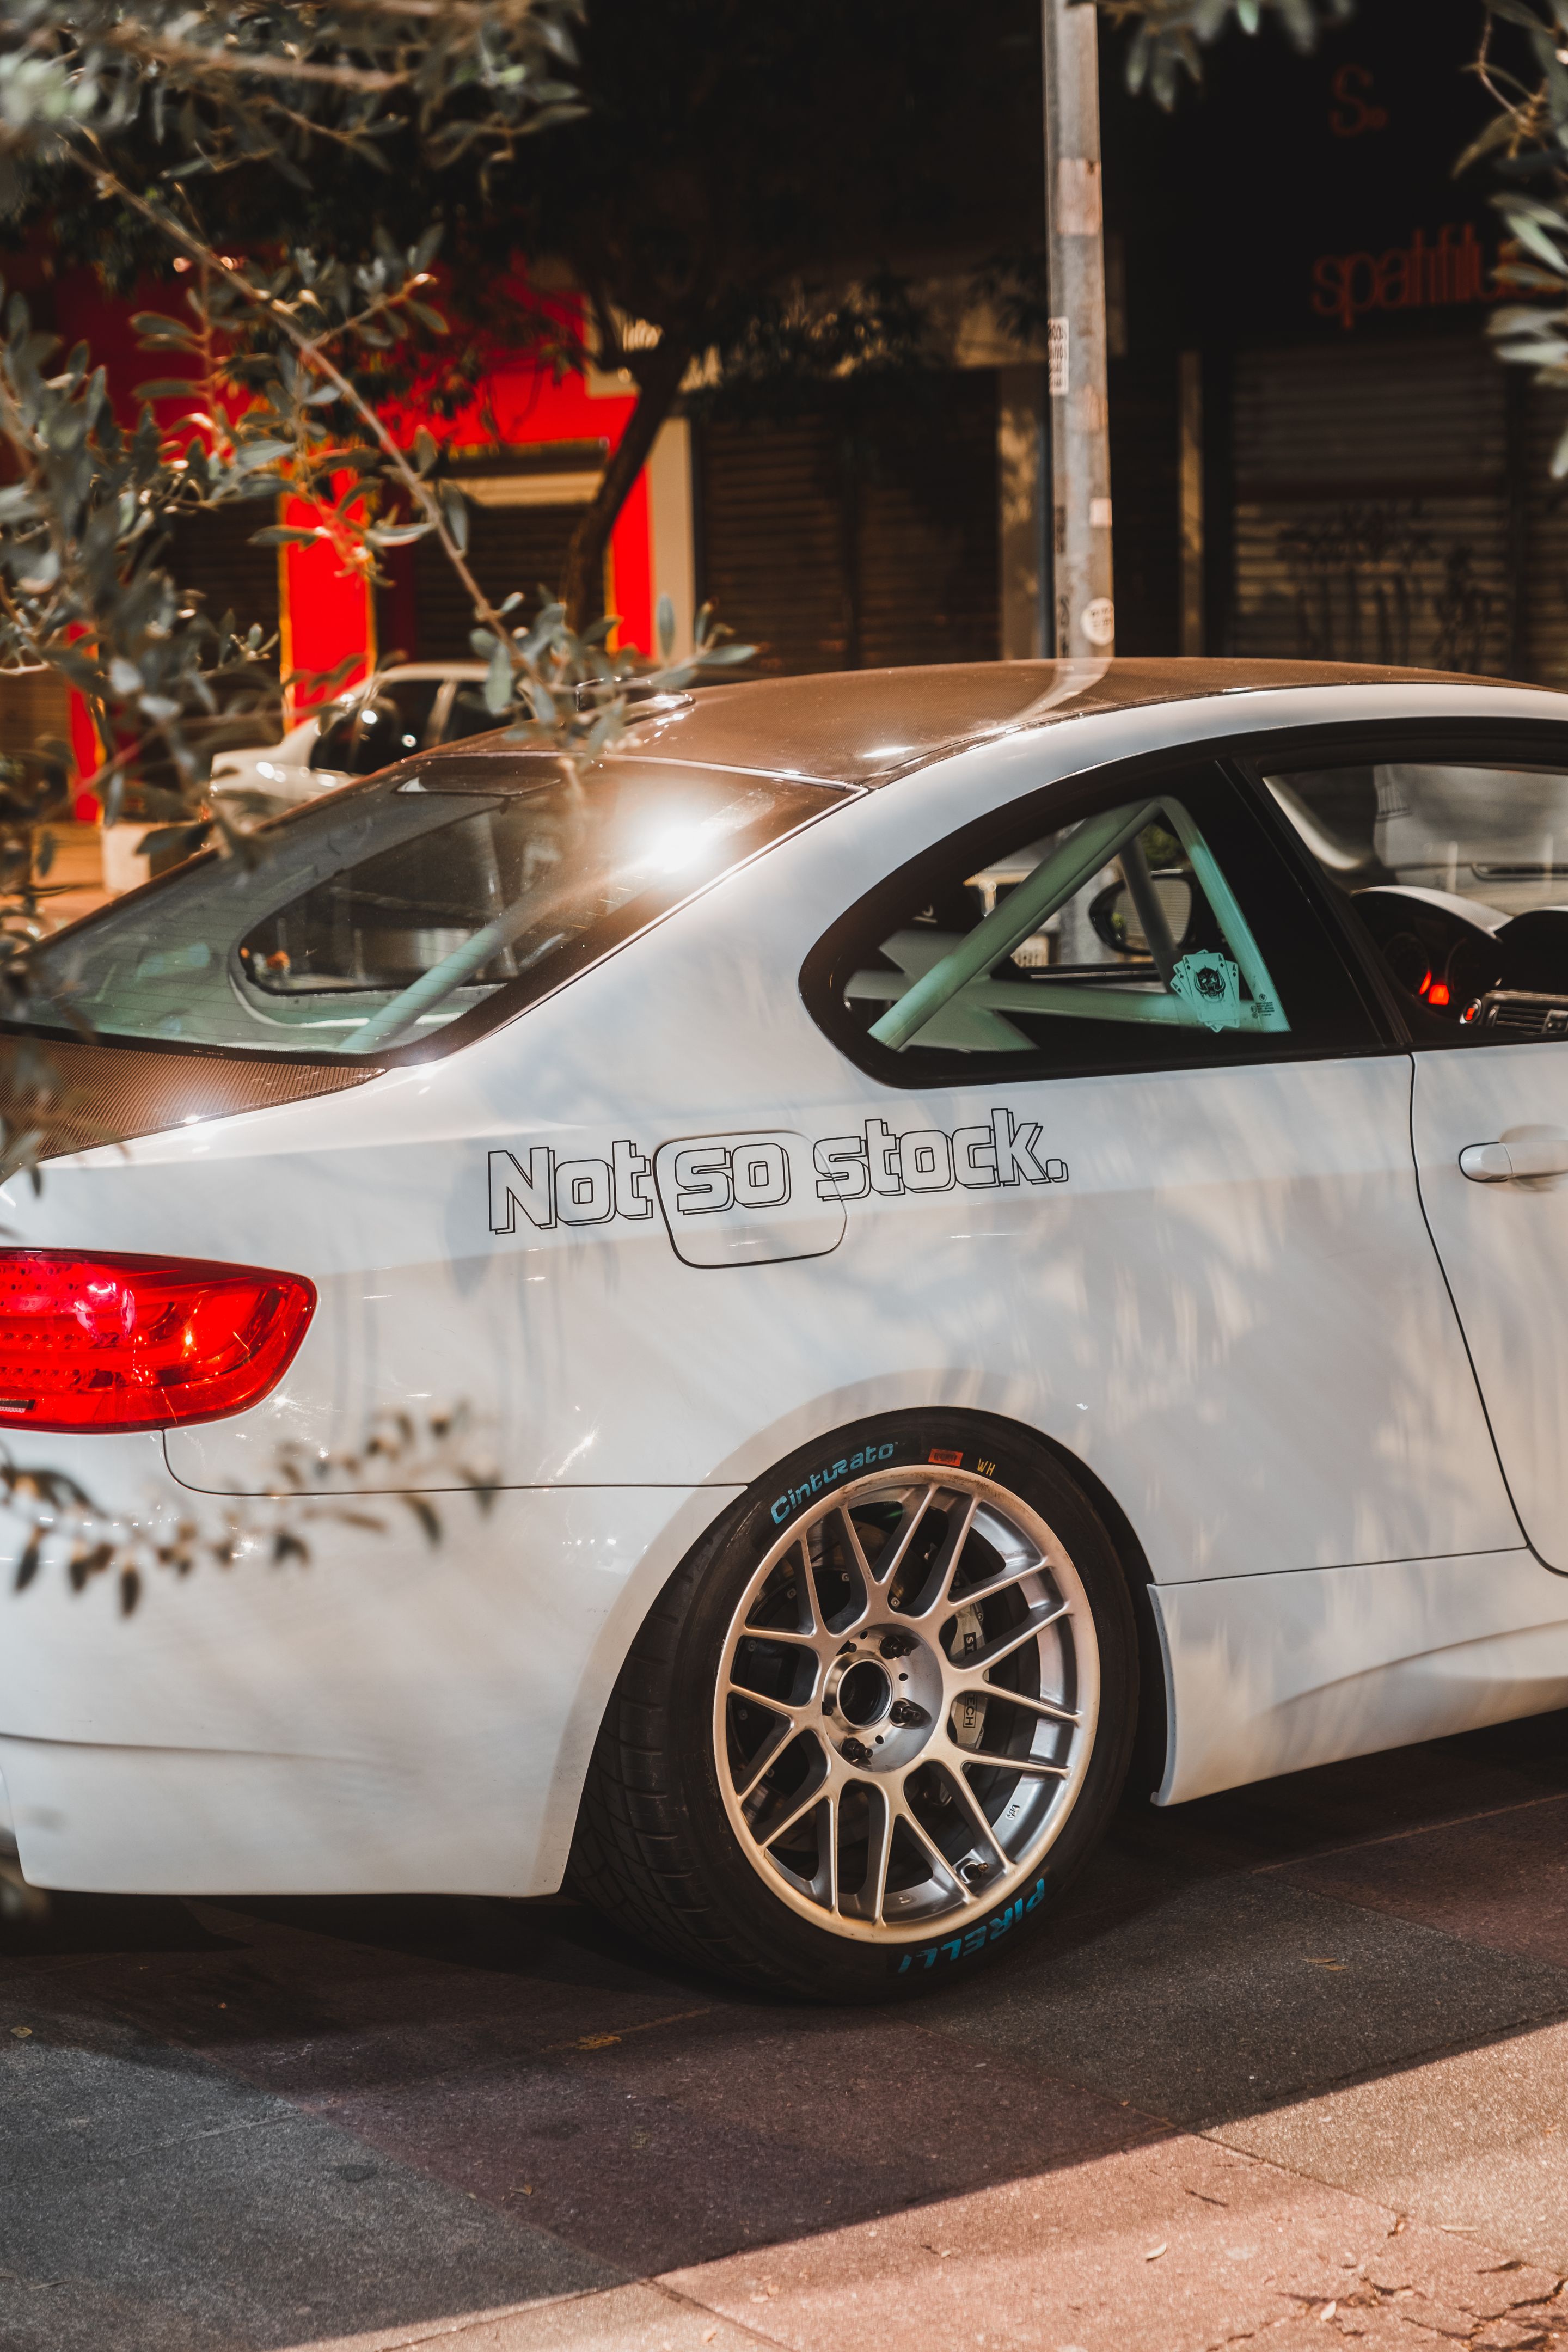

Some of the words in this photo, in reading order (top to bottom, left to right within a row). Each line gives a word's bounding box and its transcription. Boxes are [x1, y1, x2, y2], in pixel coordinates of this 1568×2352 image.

[488, 1140, 654, 1235] Not
[674, 1142, 792, 1215] so
[813, 1108, 1069, 1202] stock.
[977, 1458, 996, 1476] WH
[965, 1695, 975, 1726] ECH
[898, 1878, 1045, 1973] PIRELLI
